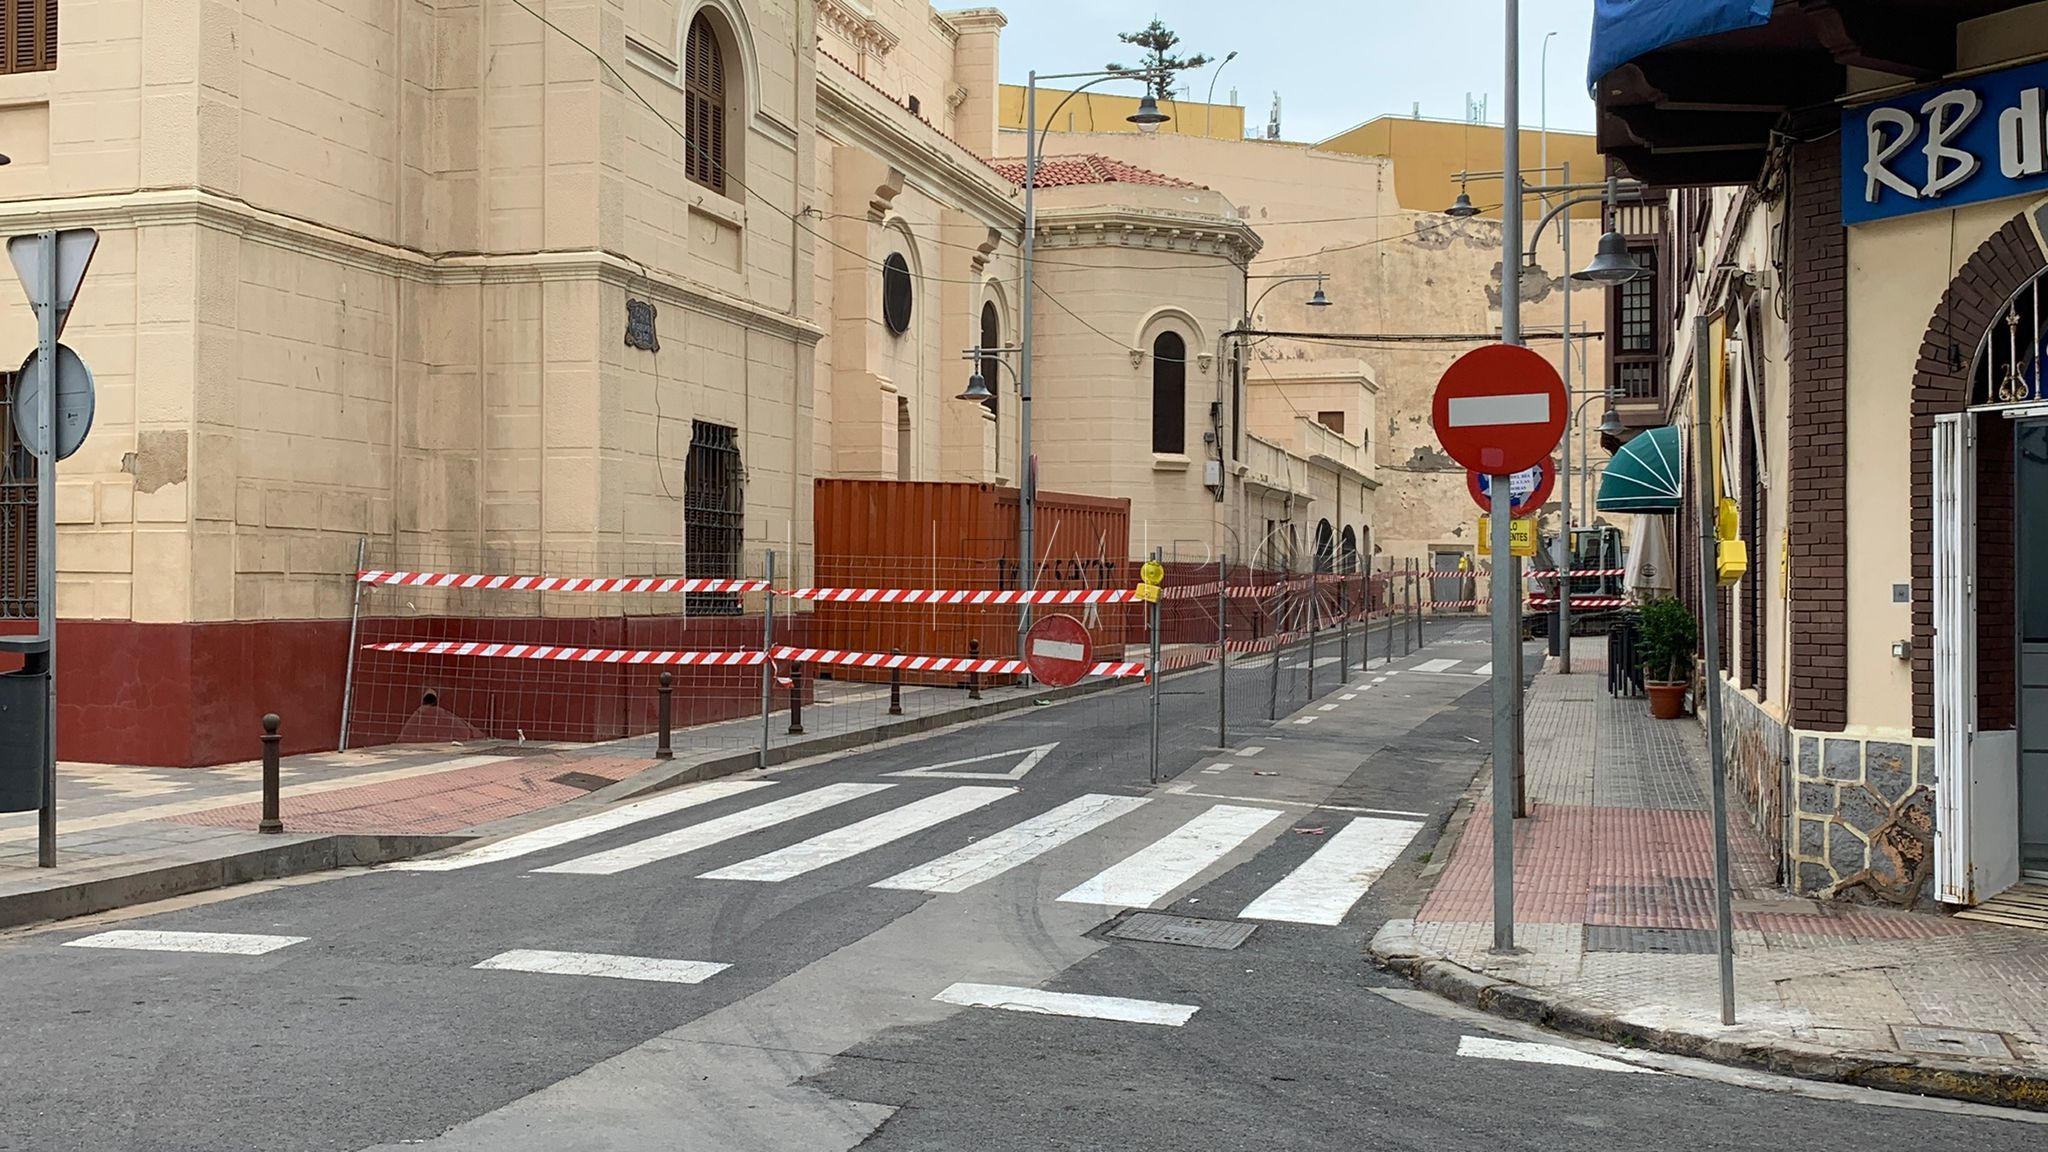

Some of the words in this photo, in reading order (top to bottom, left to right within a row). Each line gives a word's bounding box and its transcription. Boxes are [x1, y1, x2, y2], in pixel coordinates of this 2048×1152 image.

[1863, 88, 1979, 203] RB
[1998, 87, 2048, 179] d
[1509, 532, 1528, 542] ENTES
